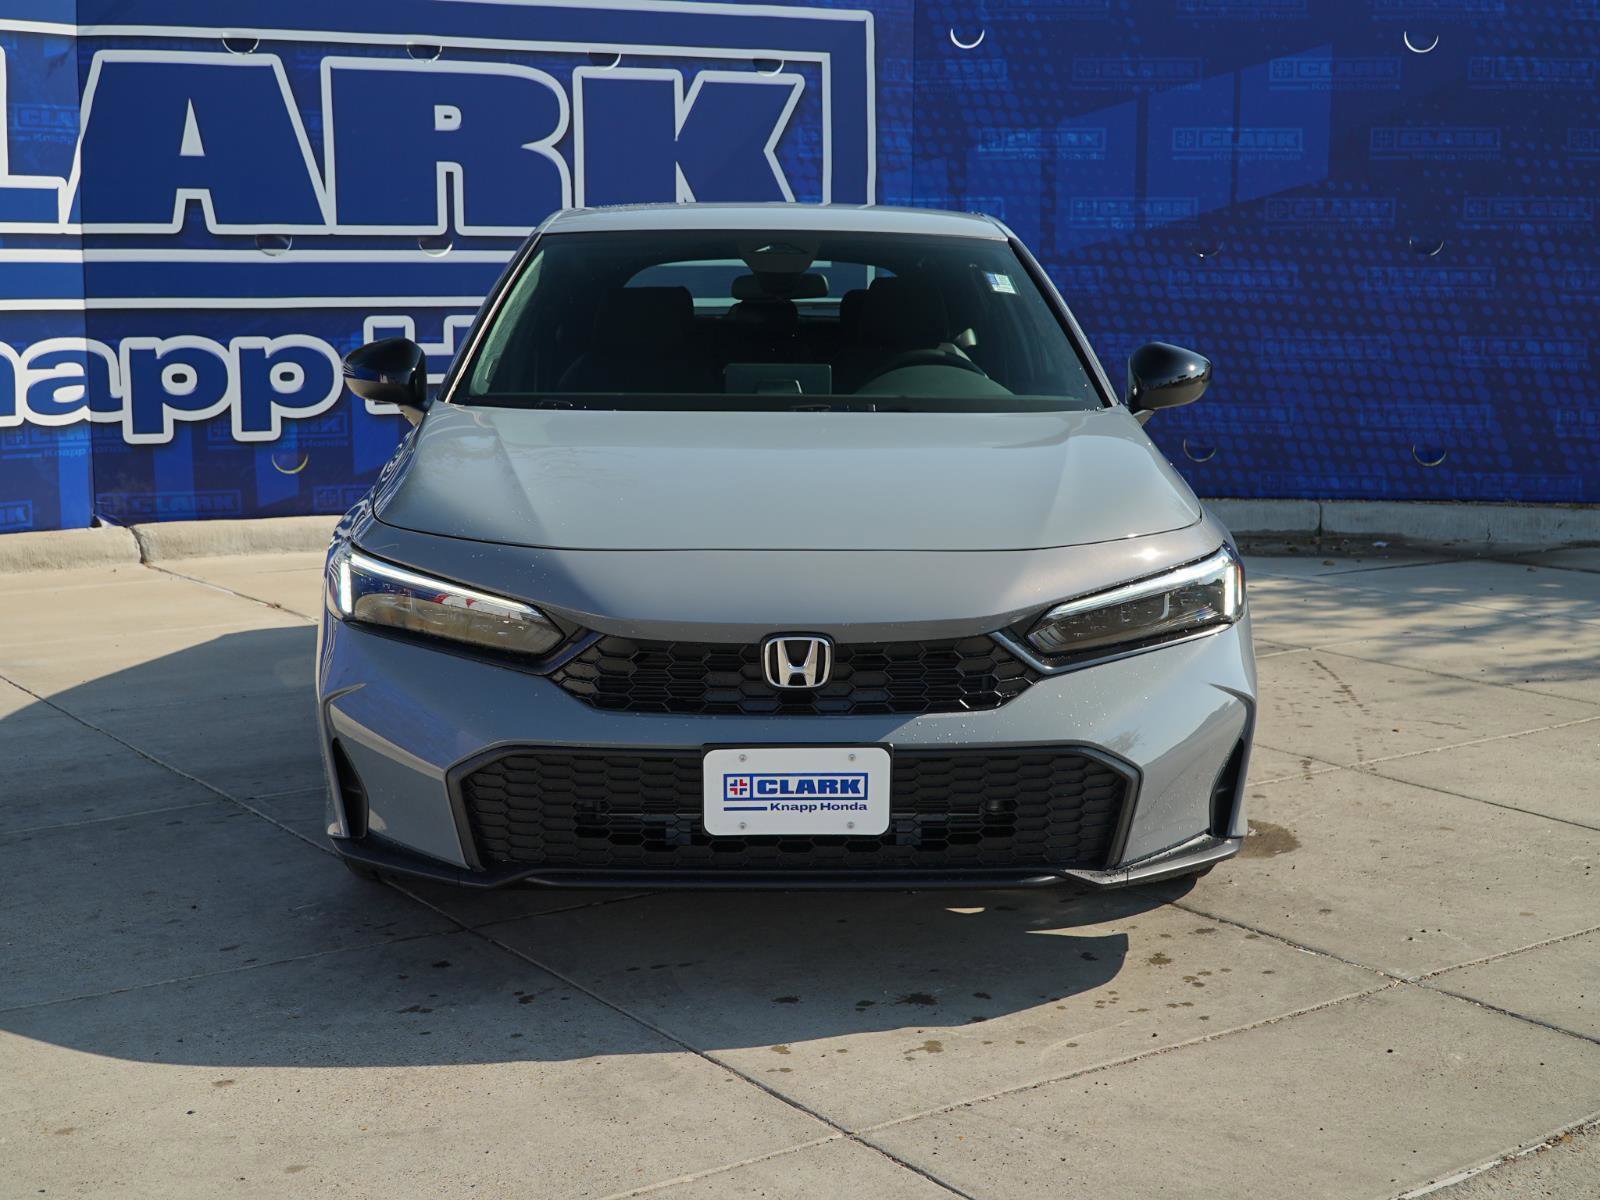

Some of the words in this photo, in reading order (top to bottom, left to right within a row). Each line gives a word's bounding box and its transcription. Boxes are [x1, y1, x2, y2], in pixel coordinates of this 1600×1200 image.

[757, 778, 861, 795] CLARK
[770, 802, 818, 813] Knapp
[820, 802, 868, 812] Honda
